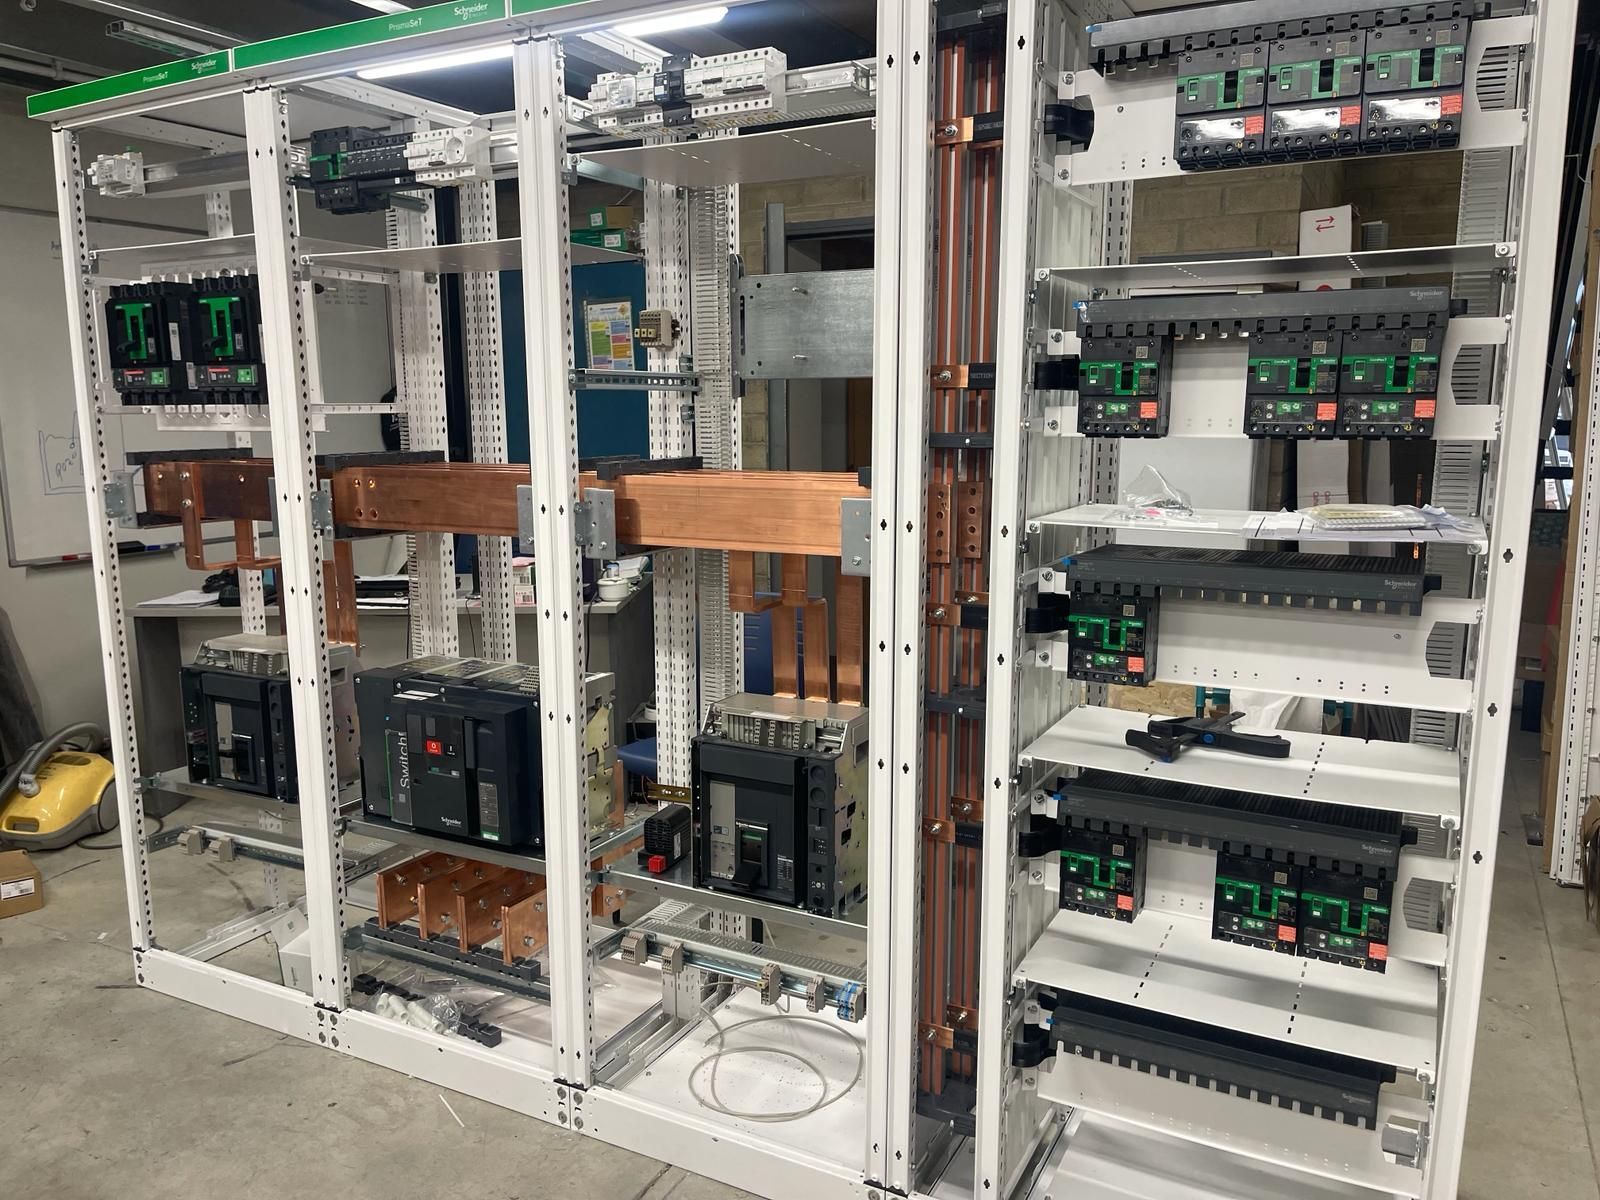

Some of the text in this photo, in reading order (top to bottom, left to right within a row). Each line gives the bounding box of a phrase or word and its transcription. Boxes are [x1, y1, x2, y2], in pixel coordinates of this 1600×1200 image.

[454, 3, 488, 20] Schneider
[191, 59, 217, 74] Schneider
[1384, 579, 1417, 590] Schneider
